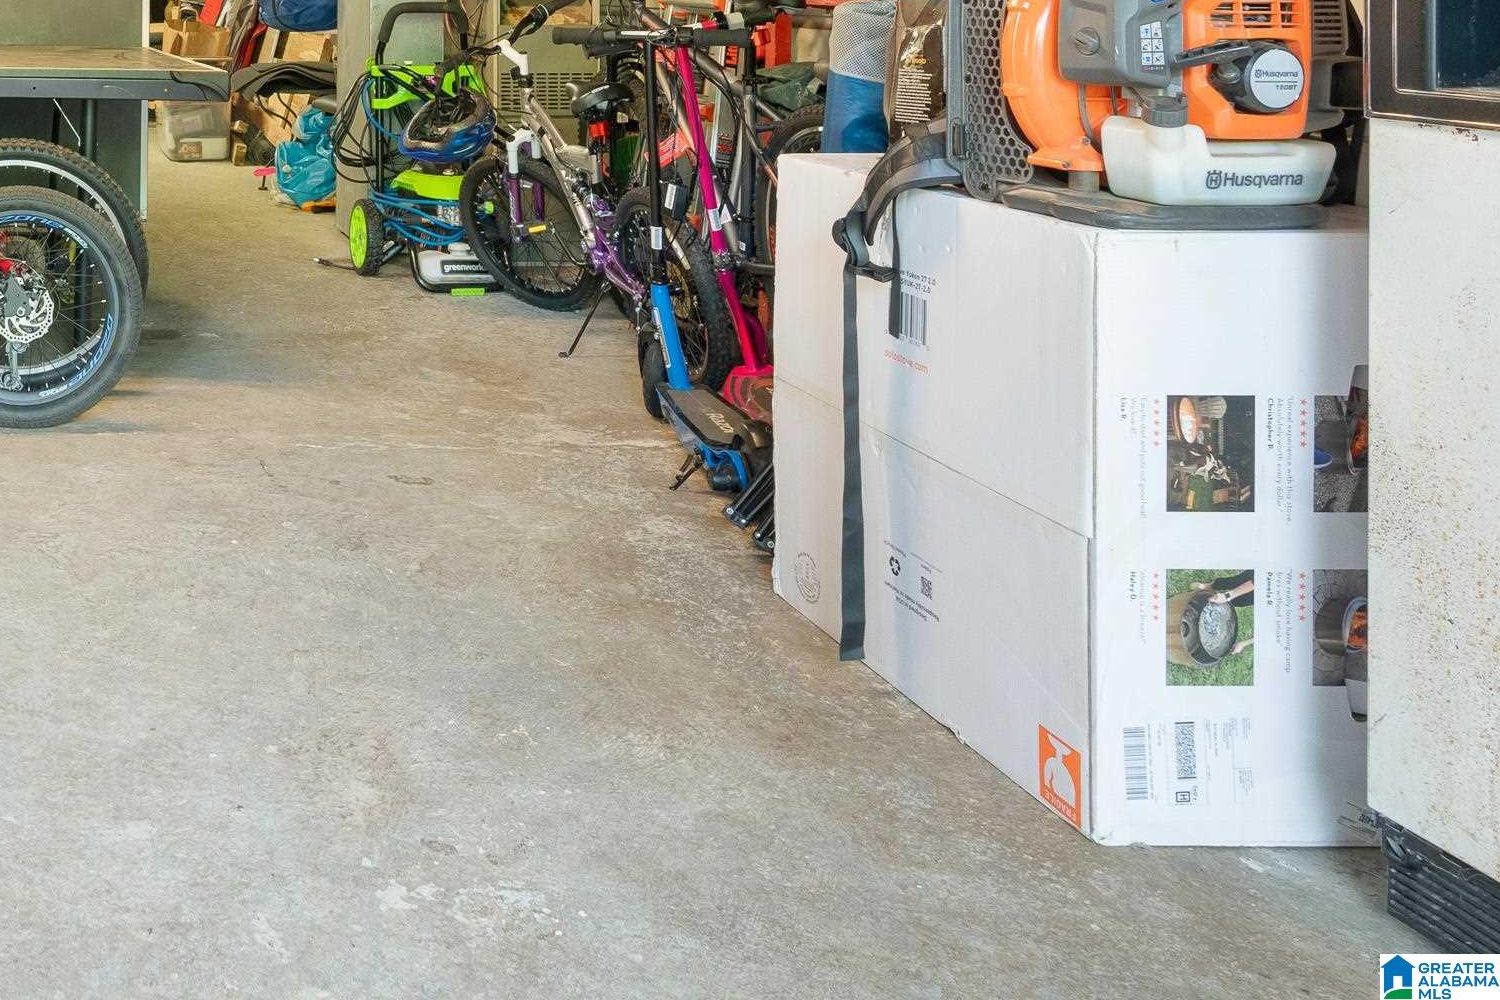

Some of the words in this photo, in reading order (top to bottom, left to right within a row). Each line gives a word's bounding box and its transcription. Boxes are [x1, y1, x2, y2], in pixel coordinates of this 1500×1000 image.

[1262, 70, 1299, 79] Husqvarna
[1223, 171, 1303, 188] Husqvarna
[444, 263, 484, 272] greenwork
[1266, 398, 1274, 442] Christopher
